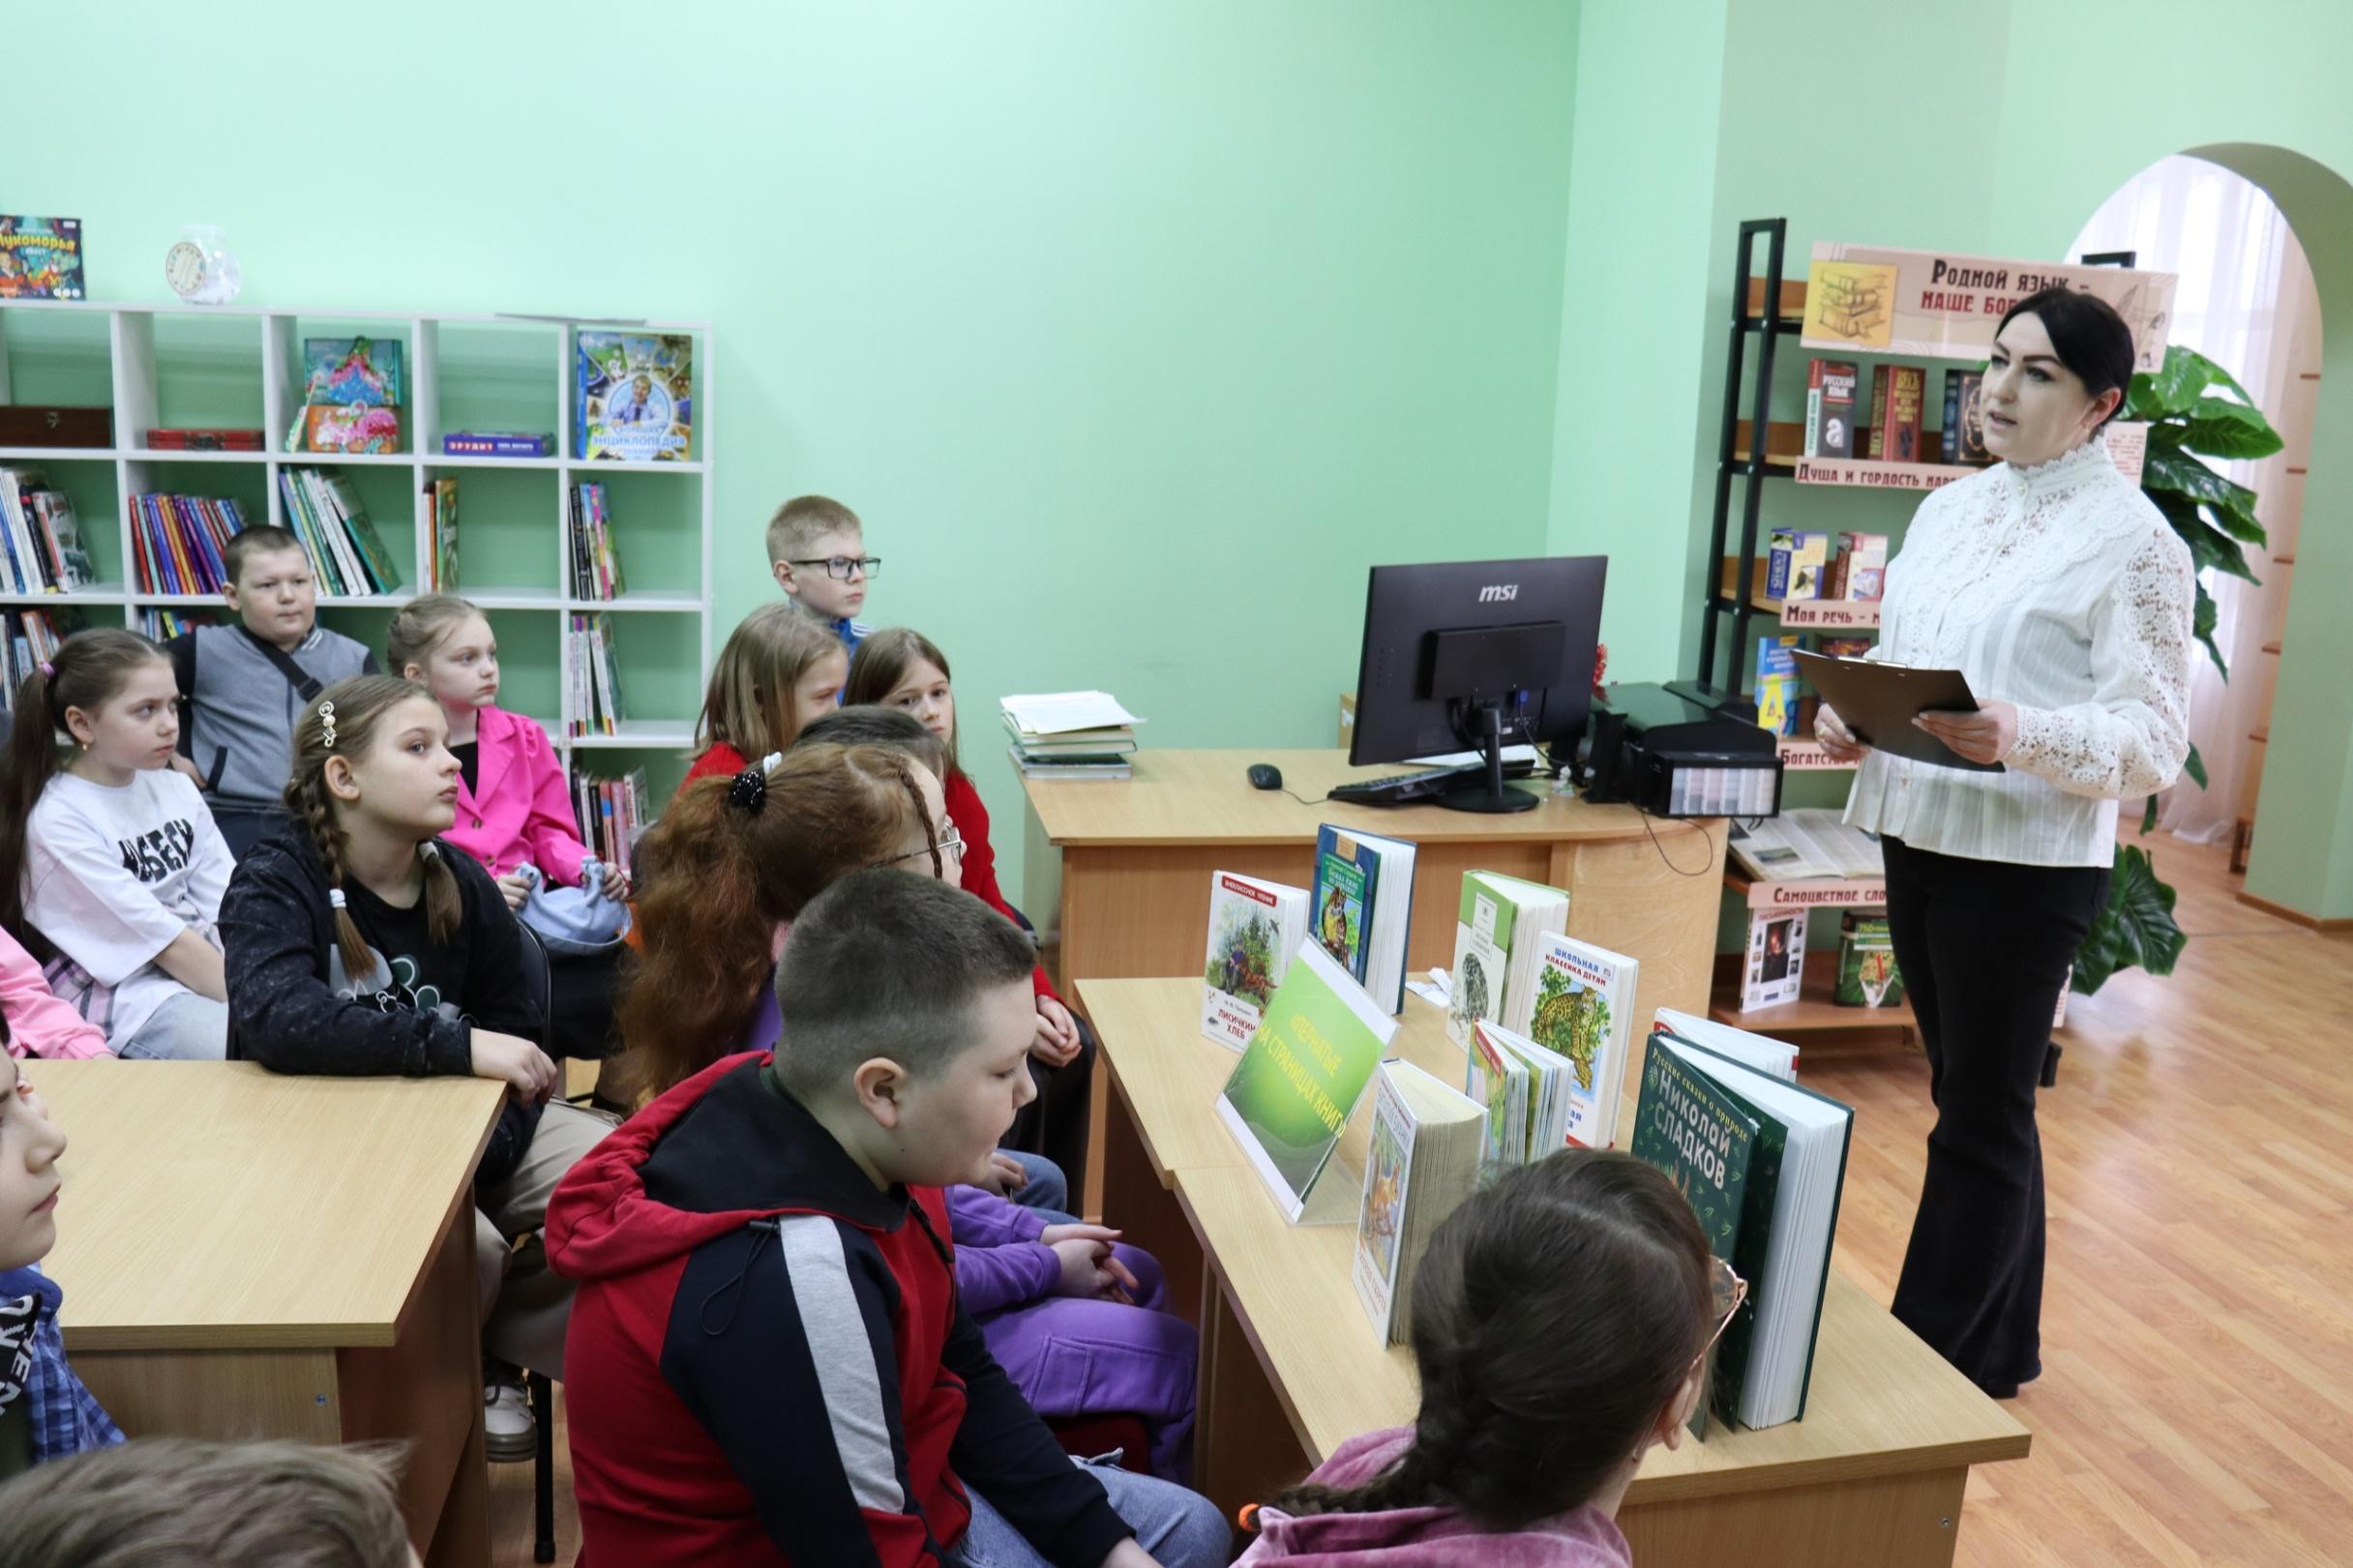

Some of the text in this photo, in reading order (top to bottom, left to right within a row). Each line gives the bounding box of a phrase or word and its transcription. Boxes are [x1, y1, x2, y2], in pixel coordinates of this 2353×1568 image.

[1478, 584, 1519, 602] msi
[1545, 953, 1607, 987] КЛАССИКА ДЕТЯМ
[1554, 947, 1599, 973] ШКОЛЬНАЯ
[1218, 1008, 1256, 1033] ЛИСИЧКИН
[1226, 1023, 1245, 1040] ХЛЕБ
[1653, 1047, 1748, 1143] Русские сказки о природе
[1654, 1101, 1726, 1190] СЛАДКОВ
